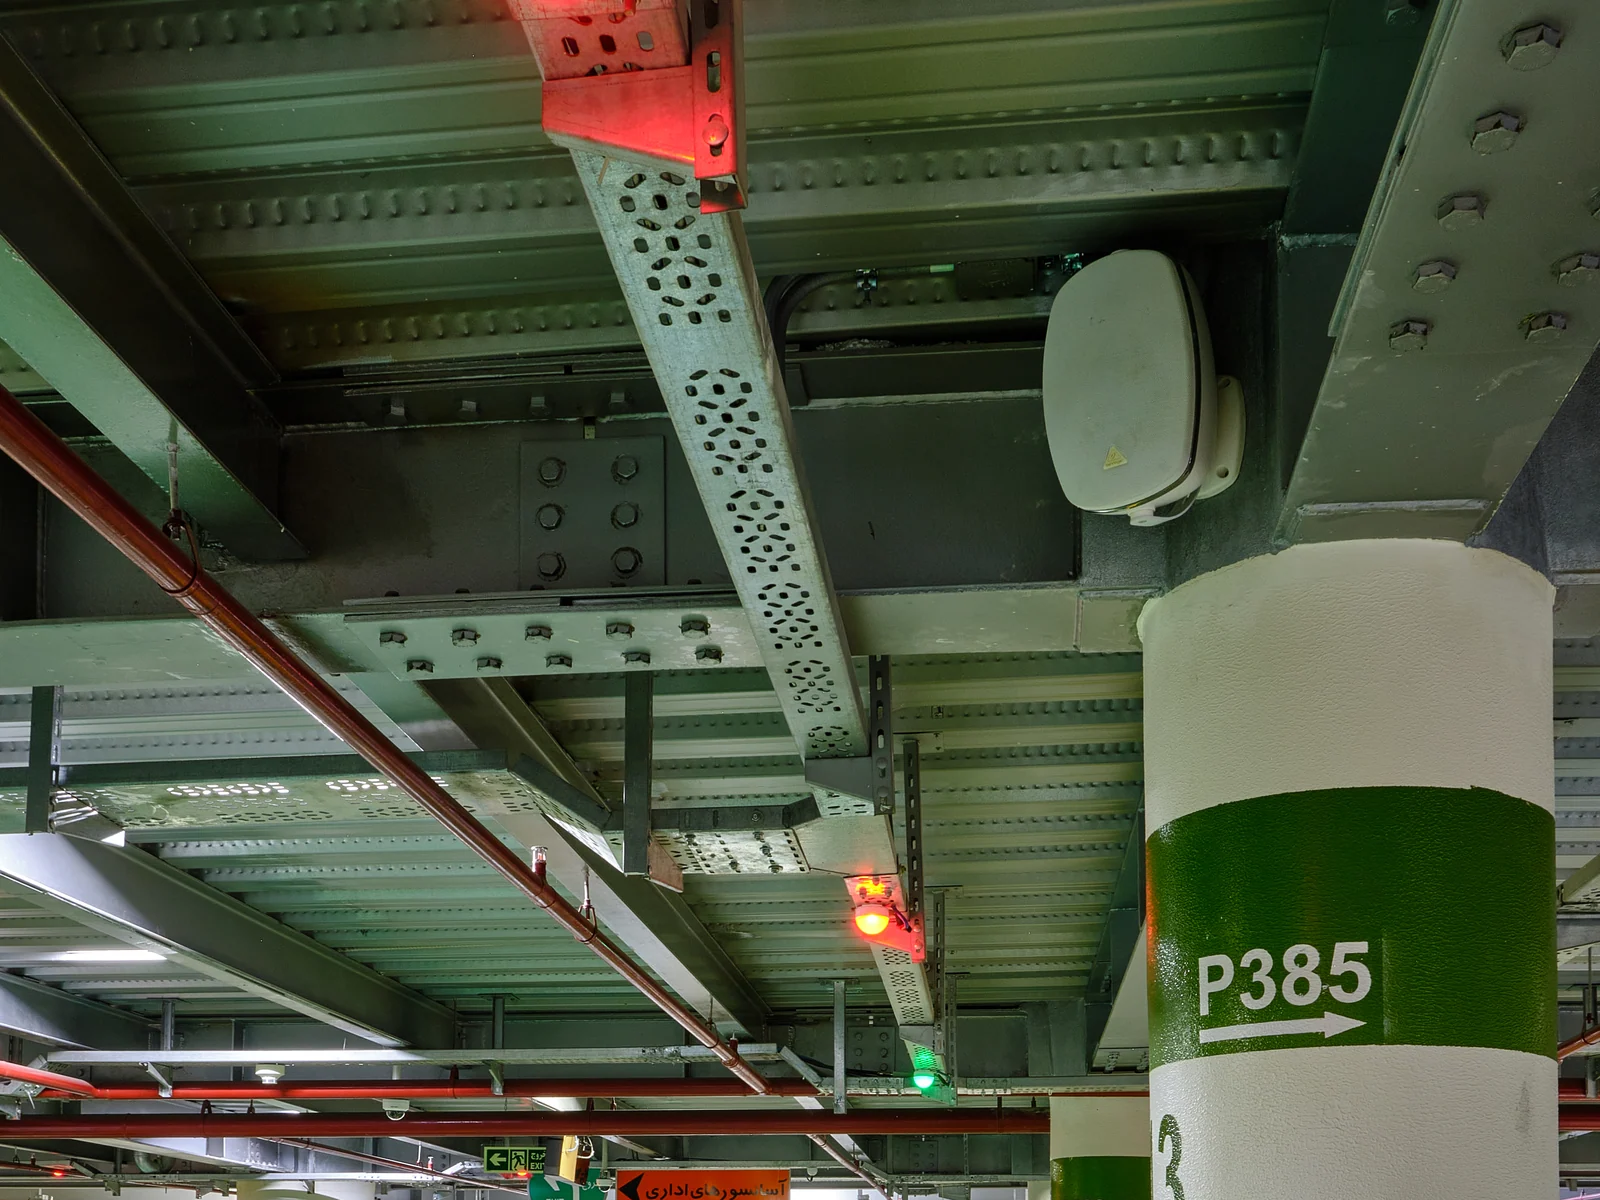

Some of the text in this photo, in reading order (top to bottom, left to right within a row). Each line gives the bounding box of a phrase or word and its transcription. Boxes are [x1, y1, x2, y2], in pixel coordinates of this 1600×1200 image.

[1198, 941, 1372, 1016] P385
[645, 1179, 788, 1200] آسانسورهای اداری
